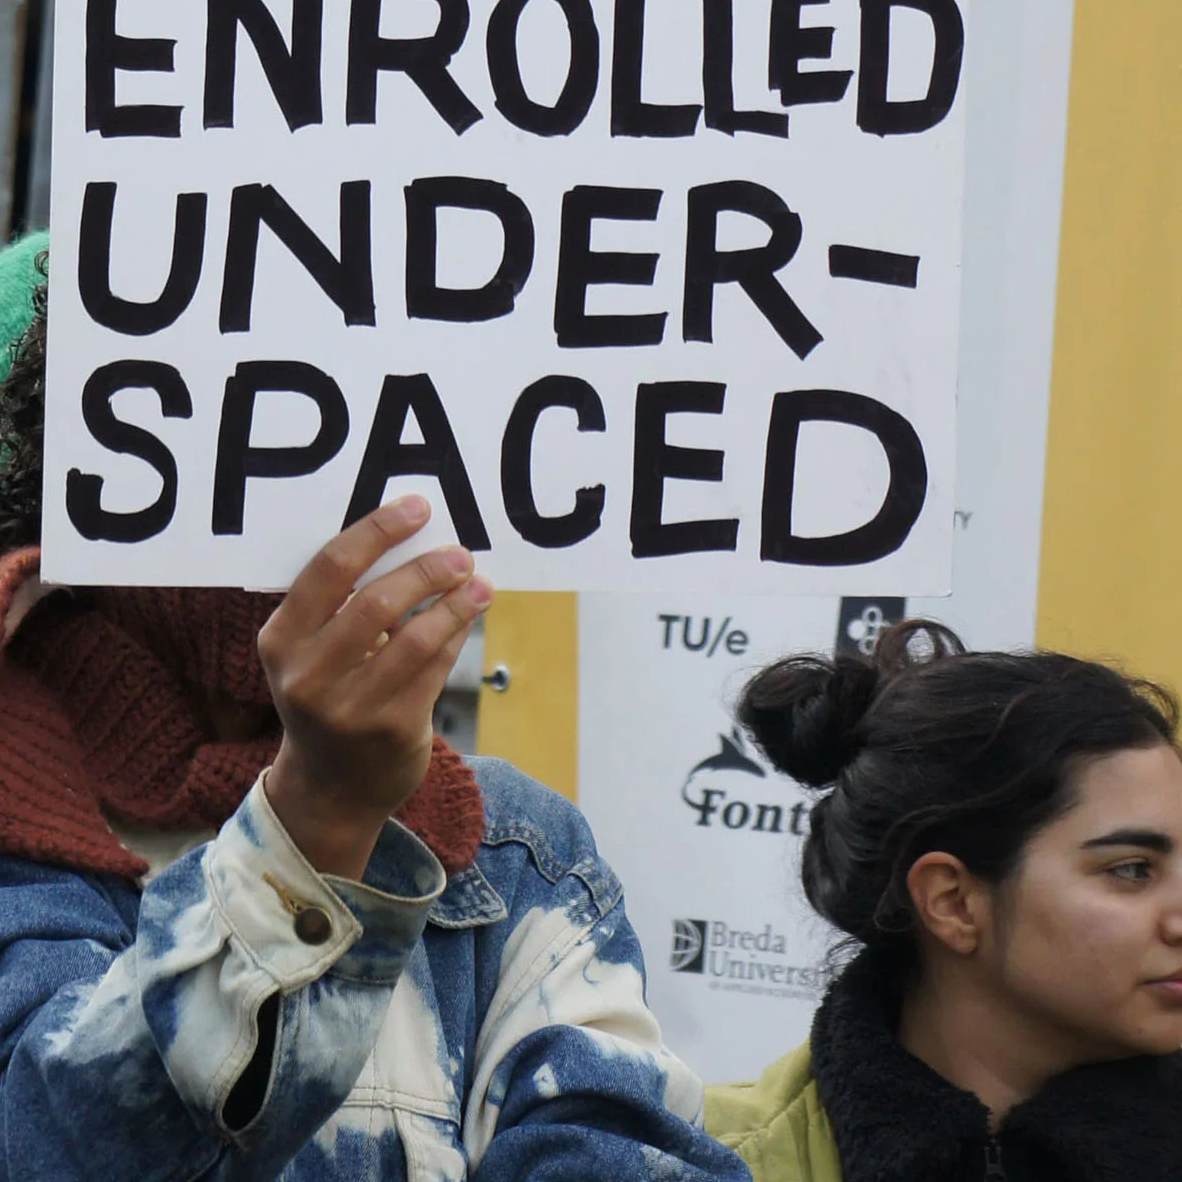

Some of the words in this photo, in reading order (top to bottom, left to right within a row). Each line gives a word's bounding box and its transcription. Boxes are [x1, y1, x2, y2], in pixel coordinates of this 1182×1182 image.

[77, 175, 921, 361] UNDER-
[65, 358, 929, 567] SPACED
[657, 613, 750, 659] TU/e
[711, 920, 788, 954] Breda
